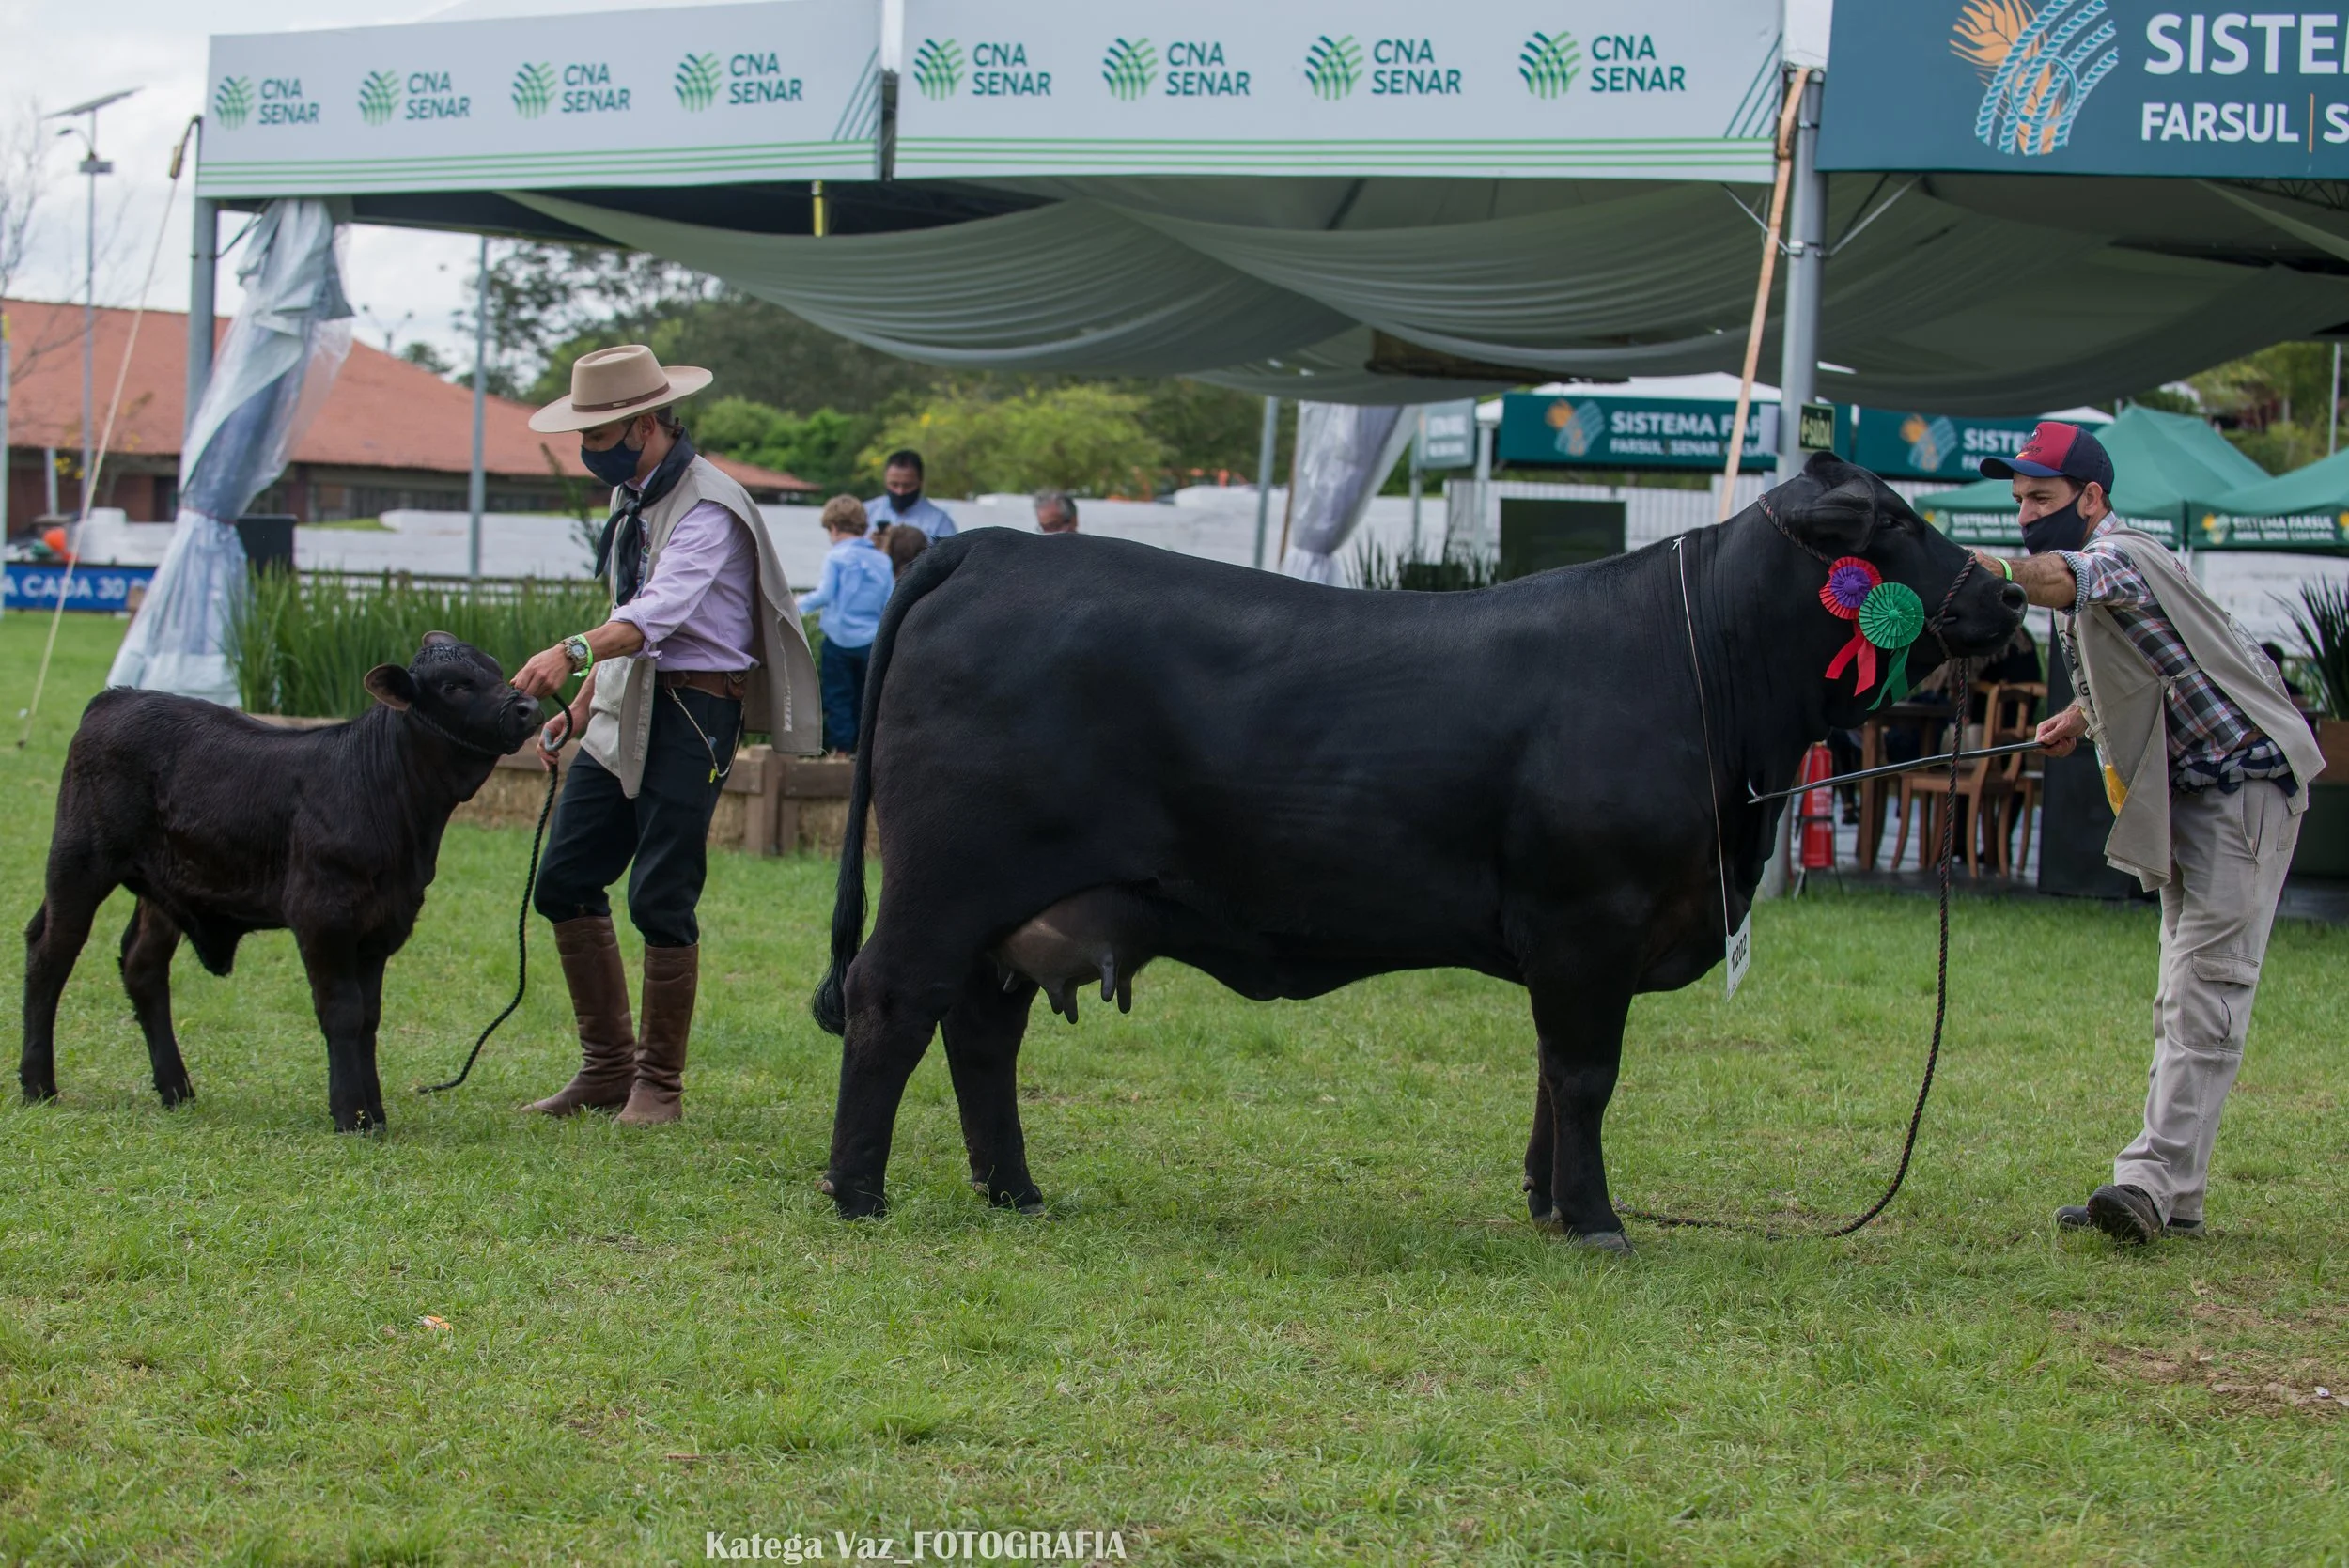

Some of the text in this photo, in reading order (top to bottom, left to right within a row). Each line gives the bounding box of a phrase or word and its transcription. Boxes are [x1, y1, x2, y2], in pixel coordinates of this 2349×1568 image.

[972, 43, 1028, 68] CNA
[1167, 42, 1225, 67] CNA
[1373, 39, 1435, 65] CNA
[1591, 35, 1657, 62] CNA
[2143, 13, 2349, 75] SISTE
[564, 63, 611, 86] CNA
[730, 53, 780, 77] CNA
[260, 78, 303, 100] CNA
[408, 72, 452, 95] CNA
[728, 78, 803, 105] SENAR
[972, 71, 1052, 96] SENAR
[1165, 71, 1251, 96] SENAR
[1371, 70, 1462, 95] SENAR
[1590, 66, 1687, 93] SENAR
[258, 102, 320, 125] SENAR
[405, 97, 470, 120] SENAR
[561, 88, 630, 114] SENAR
[2141, 101, 2299, 143] FARSUL
[1611, 411, 1717, 436] SISTEMA
[1963, 427, 2028, 454] SISTE
[22, 574, 93, 599] CADA
[97, 576, 127, 600] 30
[1731, 933, 1748, 972] 1202
